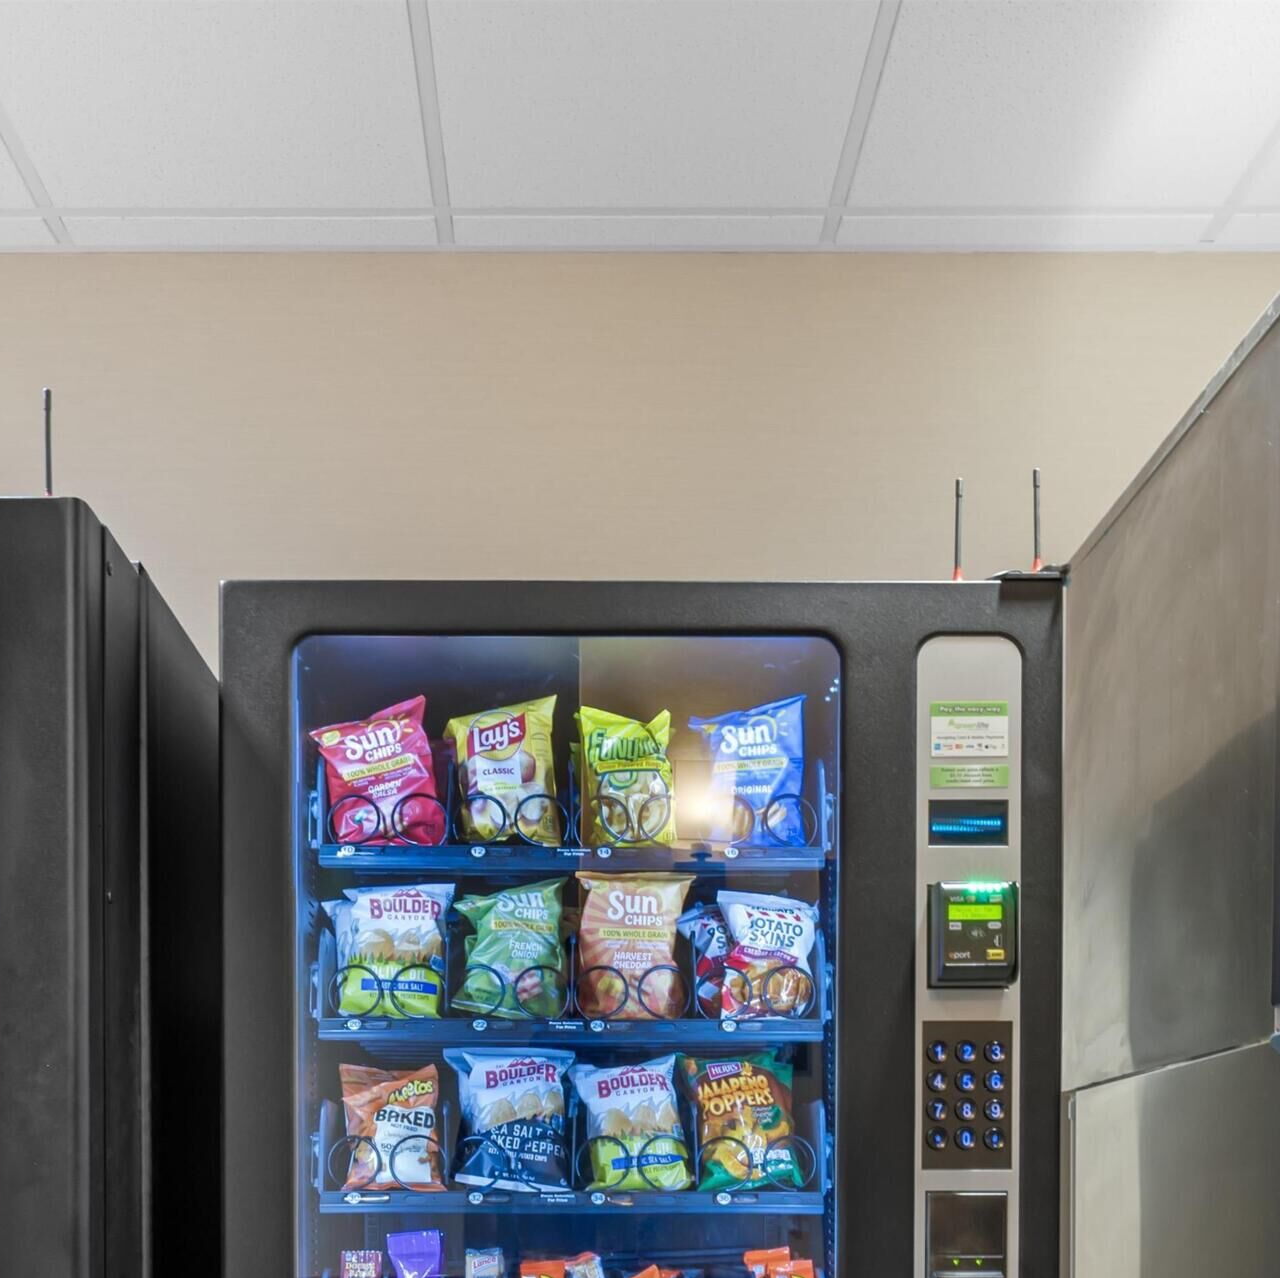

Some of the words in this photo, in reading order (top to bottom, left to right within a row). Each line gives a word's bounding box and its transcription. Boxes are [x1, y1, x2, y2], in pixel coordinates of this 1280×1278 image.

[344, 726, 395, 760] Sun
[473, 719, 522, 753] Lay's
[720, 724, 771, 754] Sun
[365, 744, 403, 763] CHIPS
[738, 743, 778, 757] CHIPS
[482, 767, 515, 776] CLASSIC
[369, 897, 442, 919] BOULDER
[496, 891, 545, 912] Sun
[607, 890, 658, 921] Sun
[387, 913, 426, 921] CANYON
[514, 908, 550, 921] CHIPS
[625, 914, 663, 926] CHIPS
[602, 930, 621, 938] 100%
[622, 930, 646, 939] WHOLE
[749, 929, 796, 948] SKINS
[509, 938, 543, 951] FRENCH
[511, 950, 539, 960] ONION
[613, 952, 653, 961] HARVEST
[613, 960, 653, 969] CHEDDAR
[934, 1045, 942, 1060] 1
[963, 1045, 972, 1059] 2
[992, 1045, 1001, 1060] 3
[485, 1063, 557, 1089] BOULDER
[502, 1075, 541, 1087] CANYON
[933, 1073, 942, 1089] 4
[962, 1074, 971, 1089] 5
[991, 1074, 1000, 1089] 6
[597, 1072, 670, 1099] BOULDER
[615, 1086, 655, 1097] CANYON
[934, 1103, 943, 1118] 7
[962, 1103, 971, 1118] 8
[991, 1103, 1000, 1118] 9
[375, 1109, 435, 1129] BAKED
[962, 1131, 971, 1146] 0
[473, 1256, 497, 1269] Lance
